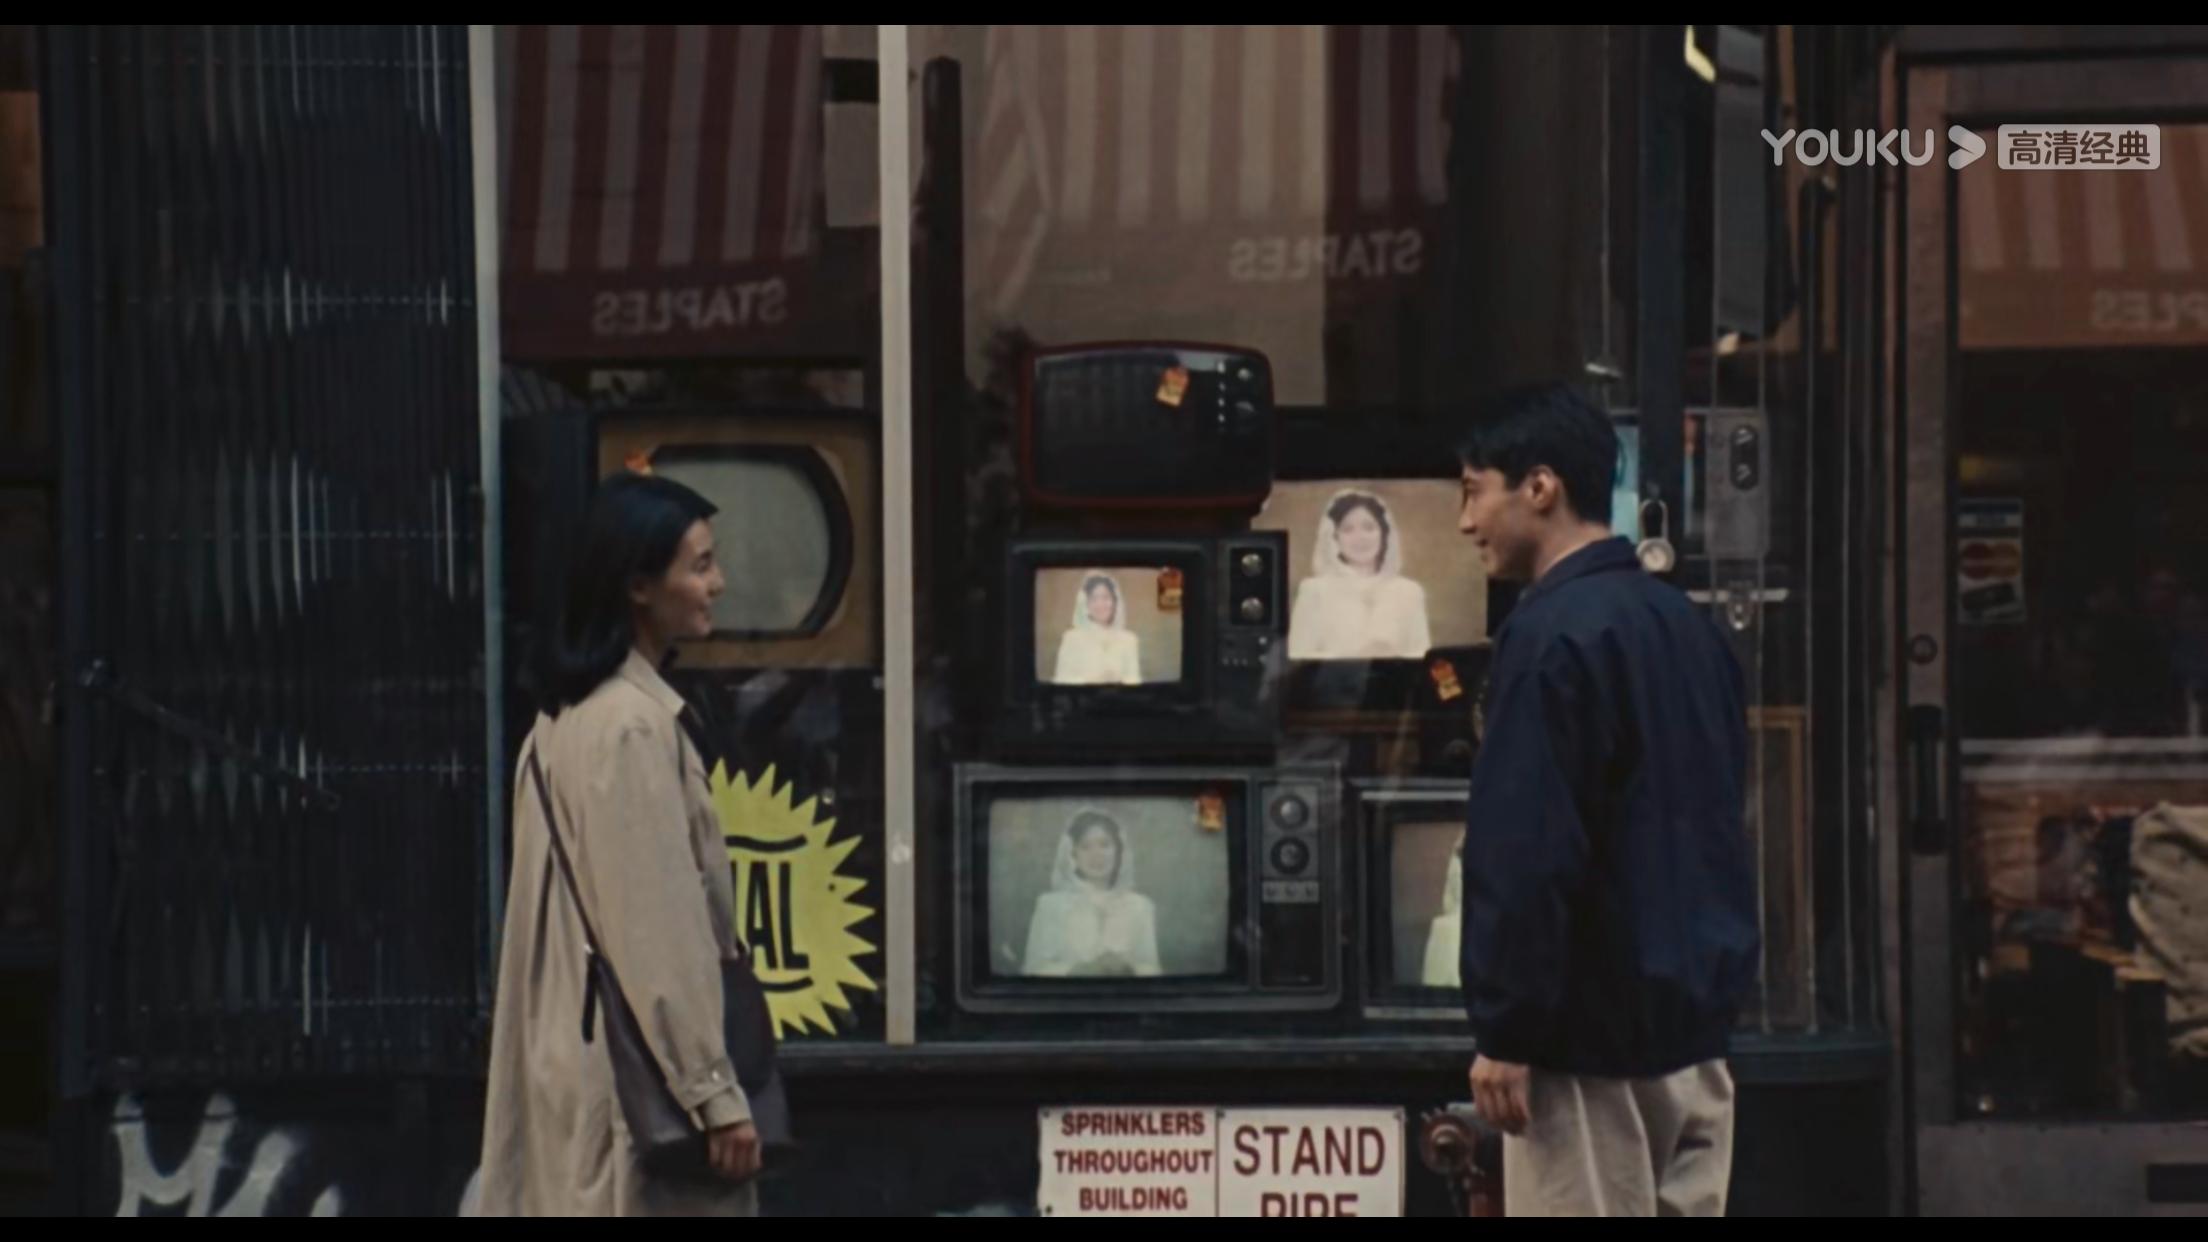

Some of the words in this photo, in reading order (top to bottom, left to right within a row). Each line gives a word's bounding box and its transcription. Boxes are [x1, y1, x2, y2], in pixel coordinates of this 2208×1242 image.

[1061, 1112, 1205, 1136] SPRINKLERS
[1054, 1150, 1213, 1174] THROUGHOUT
[1233, 1125, 1386, 1176] STAND
[1079, 1187, 1188, 1211] BUILDING
